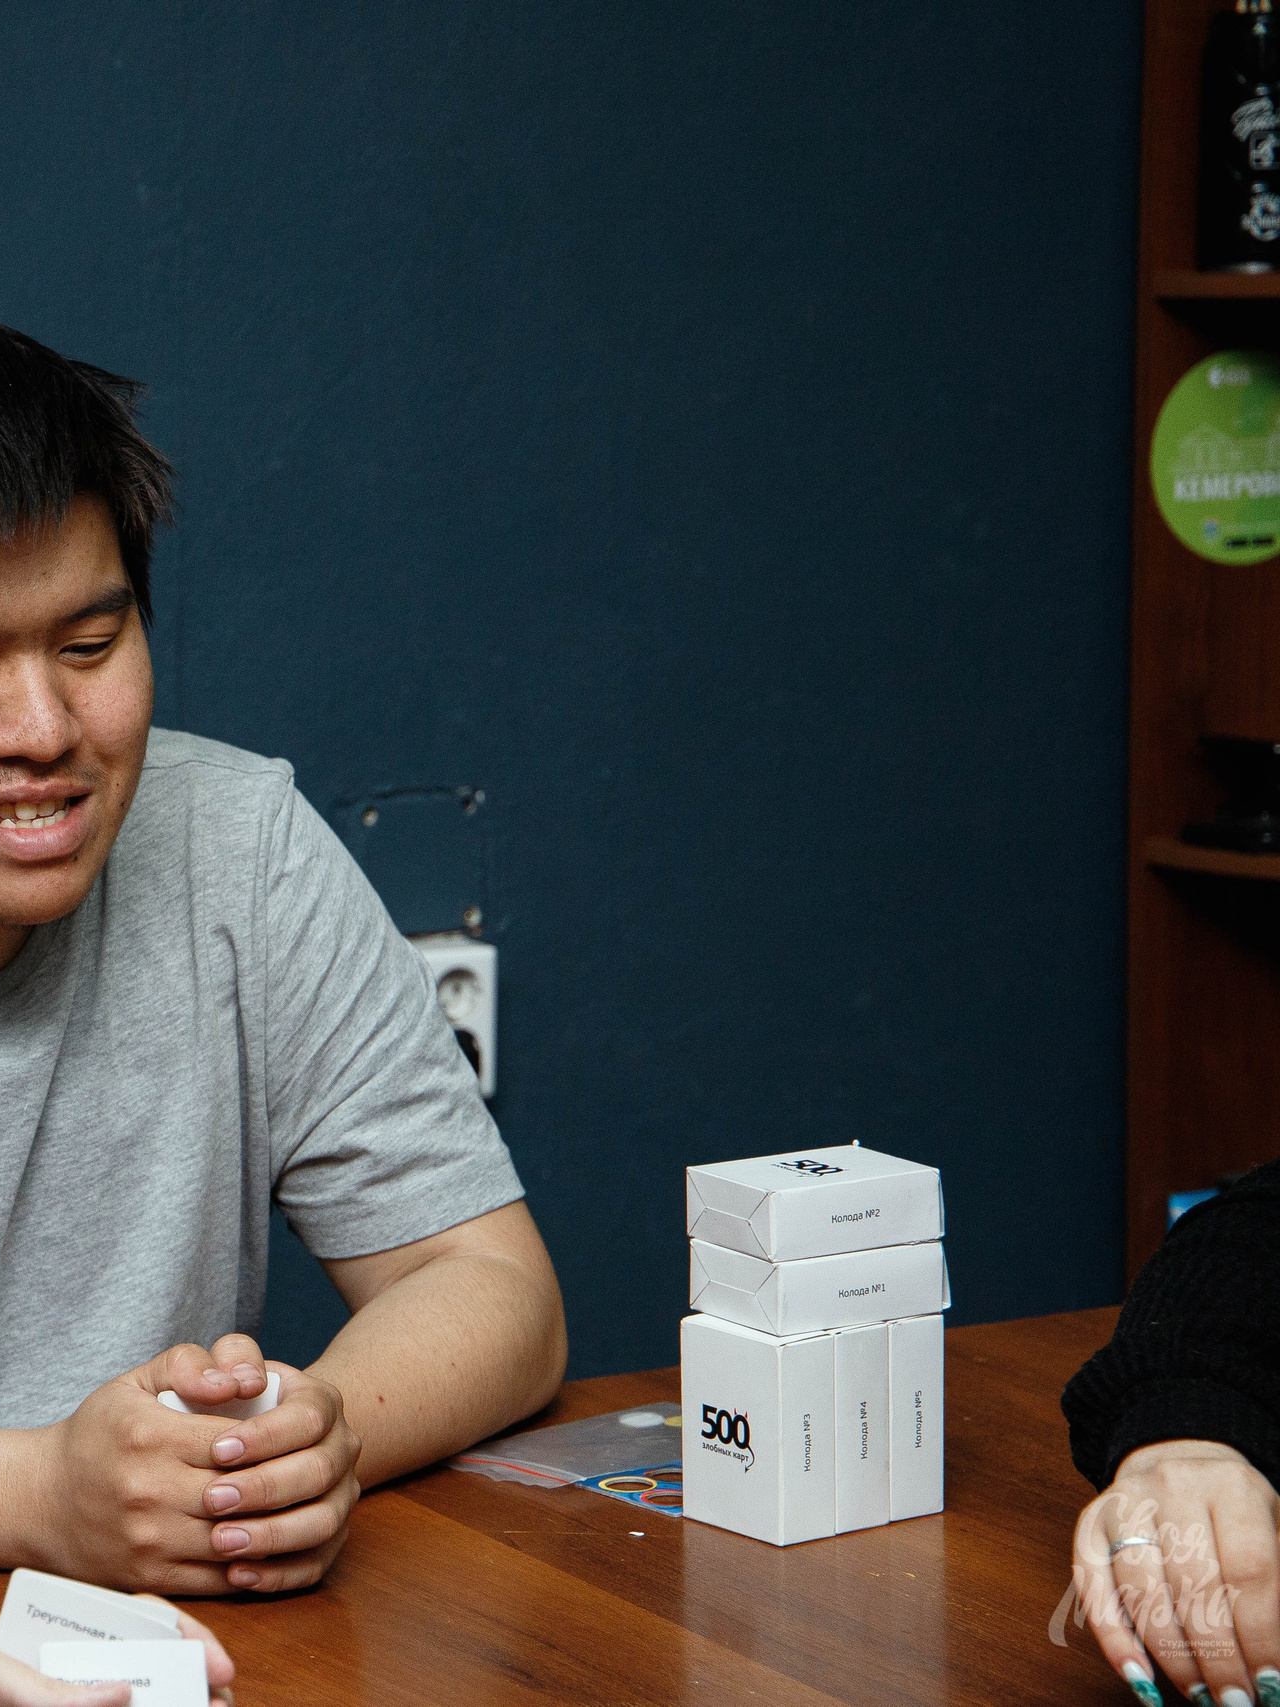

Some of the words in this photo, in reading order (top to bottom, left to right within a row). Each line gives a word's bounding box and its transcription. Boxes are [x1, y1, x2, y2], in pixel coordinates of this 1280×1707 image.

[831, 1212, 864, 1224] Колода
[865, 1208, 881, 1219] №2
[838, 1287, 870, 1299] Колода
[871, 1283, 886, 1294] №1
[860, 1401, 868, 1420] №4
[914, 1390, 923, 1409] №5
[700, 1403, 751, 1450] 500
[803, 1413, 811, 1432] №3
[914, 1410, 923, 1449] Колода
[860, 1421, 869, 1460] Колода
[702, 1442, 732, 1458] злобных
[733, 1451, 750, 1464] карт
[803, 1433, 812, 1473] Колода
[26, 1603, 107, 1641] Треугольная
